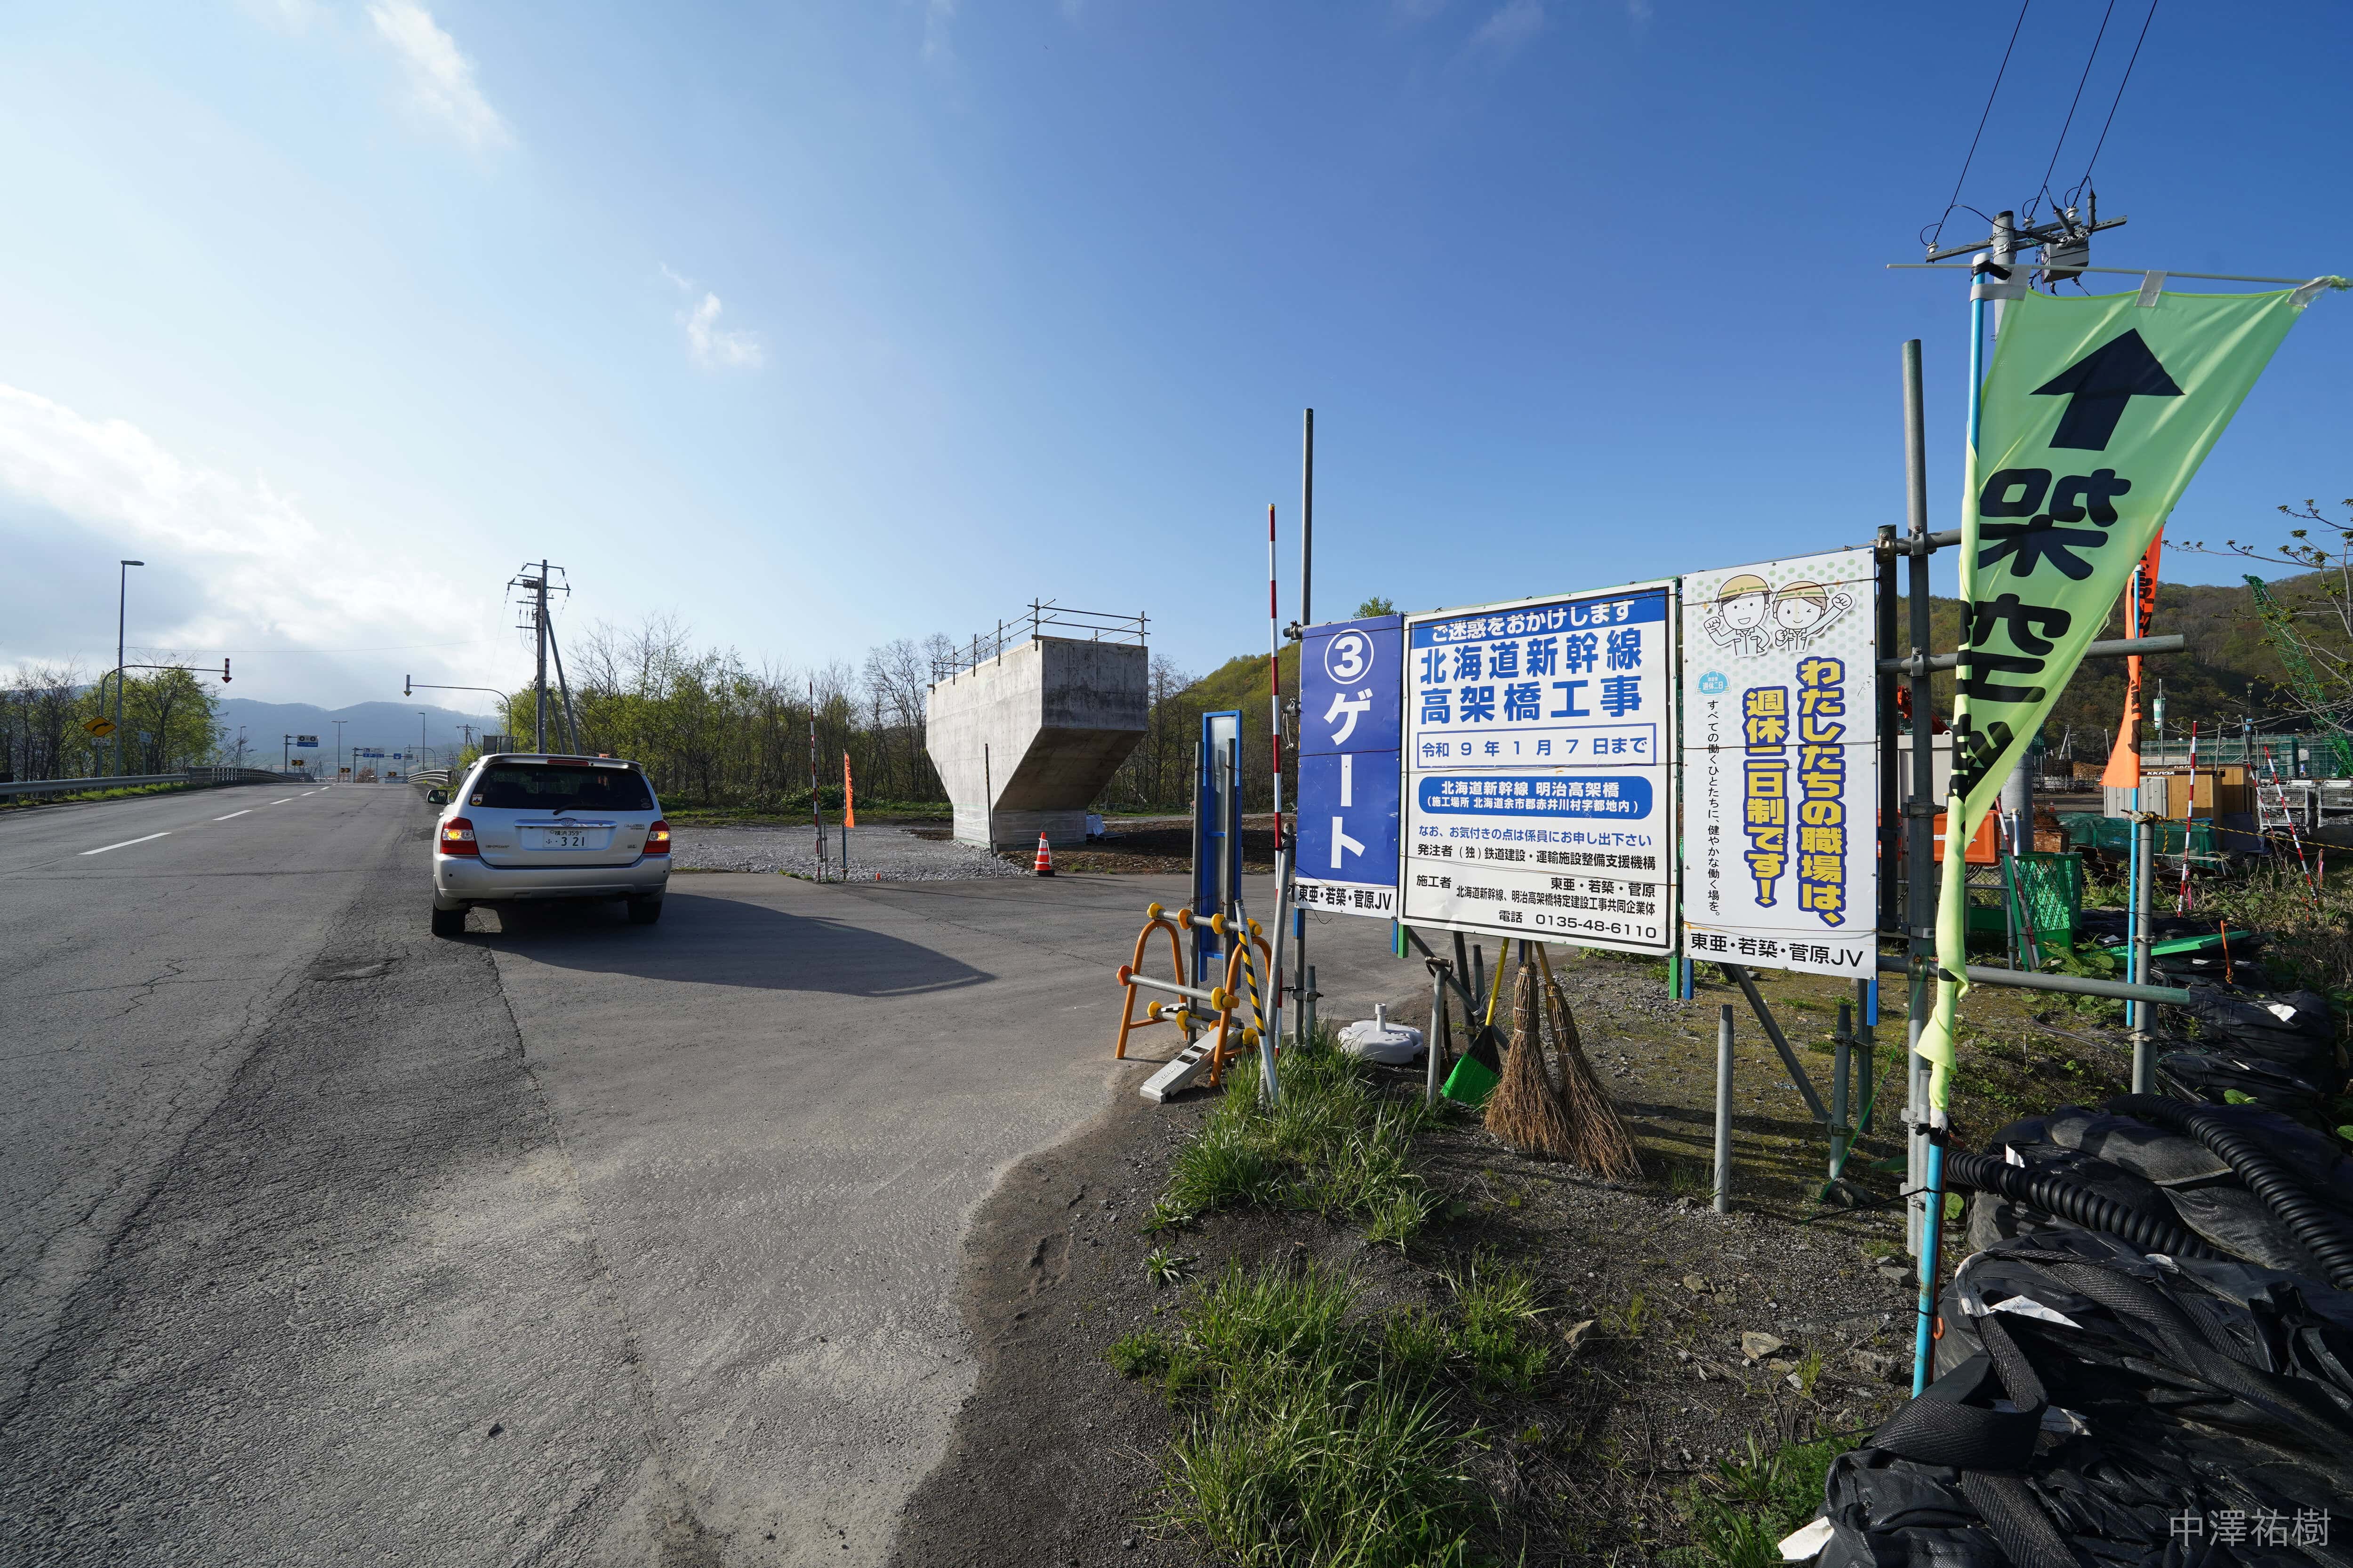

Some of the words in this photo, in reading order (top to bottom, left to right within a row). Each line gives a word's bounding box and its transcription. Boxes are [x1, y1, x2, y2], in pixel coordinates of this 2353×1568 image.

[1432, 600, 1635, 642] ご迷惑をおかけします
[1421, 627, 1642, 684] 北海道新幹線
[1421, 675, 1642, 725] 高架橋工事
[1441, 781, 1528, 796] 北海道新幹線
[1536, 782, 1619, 798] 明治高架橋
[1744, 687, 1788, 907] 週休二日制です！
[1797, 657, 1846, 927] わたしたちの職場は、
[1707, 700, 1720, 916] すべての働くひとたちに、健やかな働く場を。
[1418, 844, 1453, 857] 発注者
[1419, 825, 1652, 847] なお、お気付きの点は係員にお申し出下さい
[1416, 875, 1452, 889] 施工者
[1551, 877, 1655, 897] 東亜・若築・菅原
[1456, 885, 1655, 916] 北海道新幹線、明治高架橋特定建設工事共同企業体
[1499, 910, 1523, 924] 電話
[1535, 914, 1657, 938] 0135-48-6110
[1690, 933, 1864, 967] 東亜・若築・菅原JV
